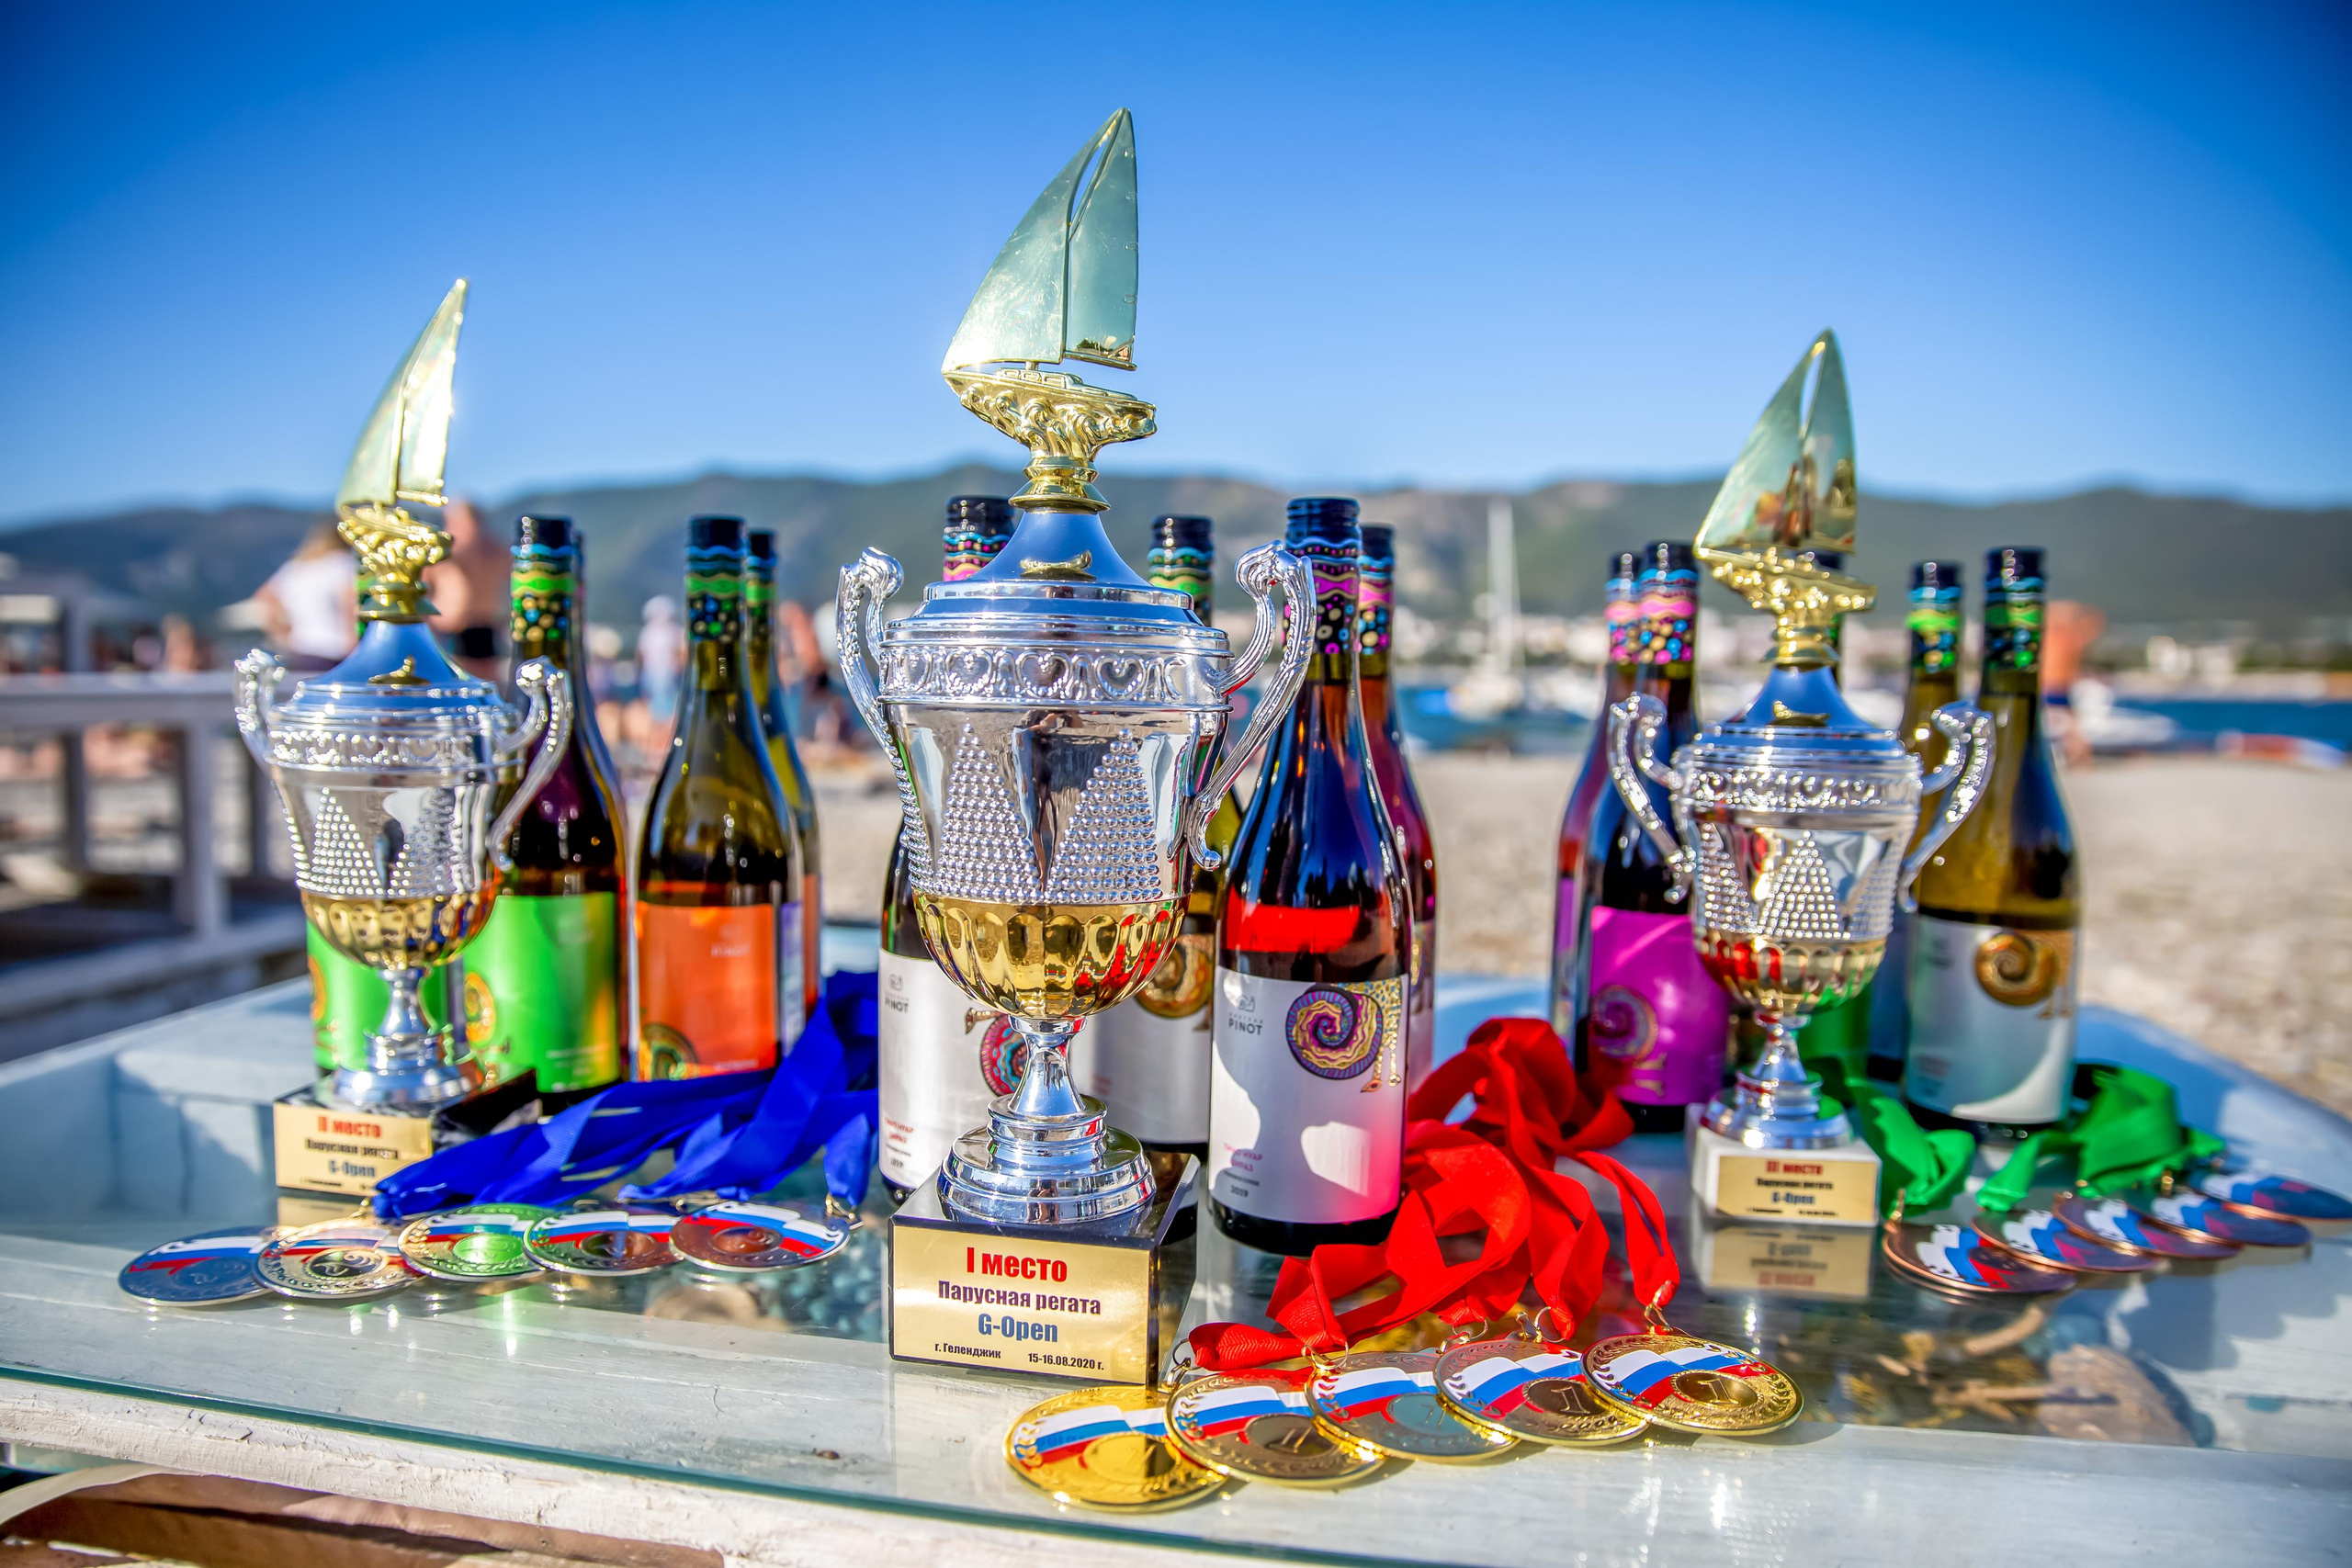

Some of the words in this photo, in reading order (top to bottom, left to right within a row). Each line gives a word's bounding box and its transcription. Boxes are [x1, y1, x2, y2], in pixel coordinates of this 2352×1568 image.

[1228, 1018, 1262, 1035] PINOT
[981, 1252, 1069, 1283] место
[938, 1280, 1031, 1308] Парусная
[1035, 1294, 1102, 1315] регата
[978, 1313, 1058, 1343] G-Open
[934, 1343, 942, 1353] г.
[943, 1342, 1001, 1359] Геленджик
[1027, 1352, 1095, 1371] 15-16.08.2020
[1550, 1385, 1591, 1415] 1
[1697, 1378, 1739, 1405] 1
